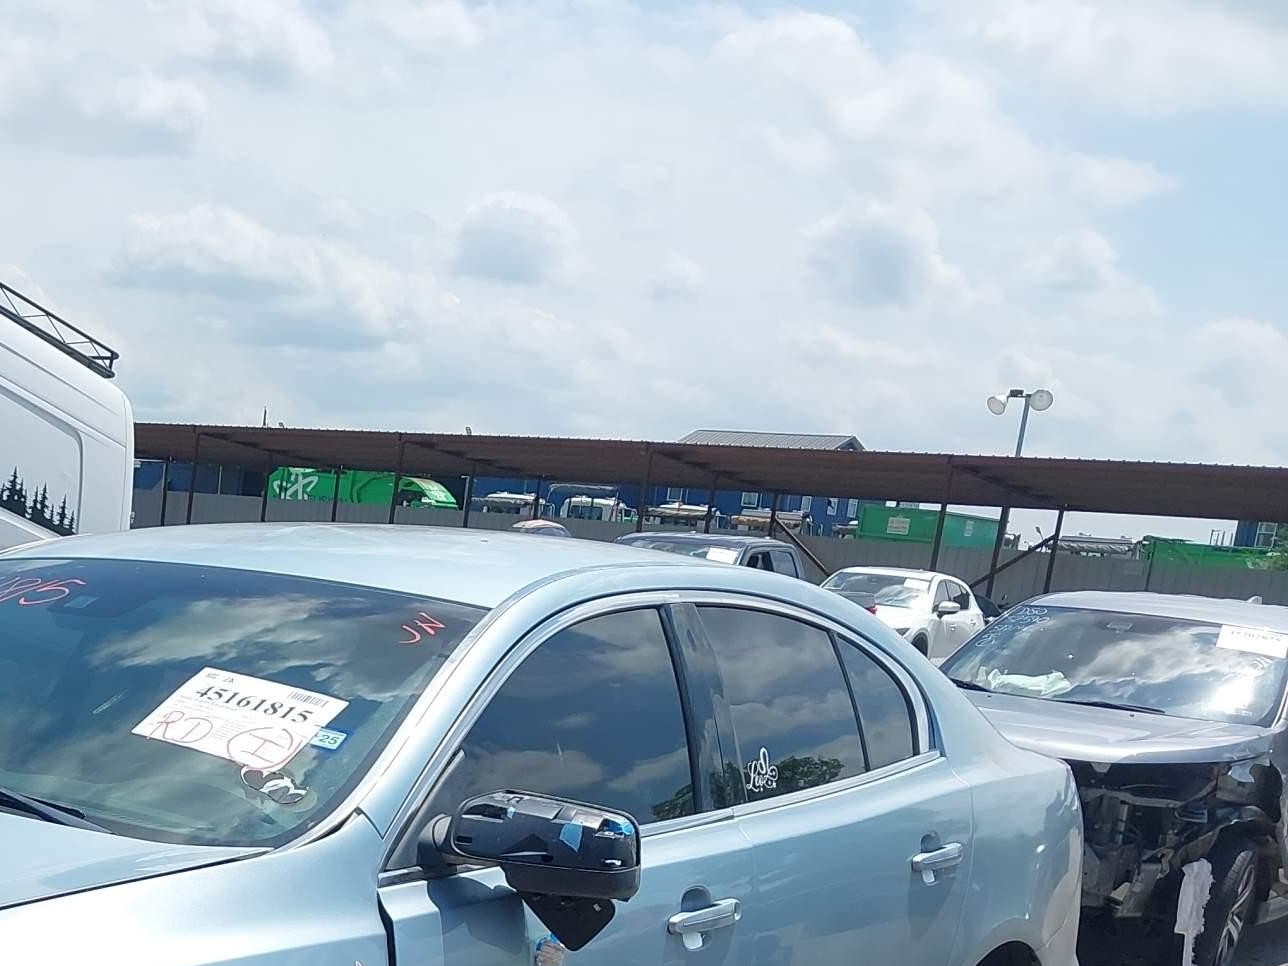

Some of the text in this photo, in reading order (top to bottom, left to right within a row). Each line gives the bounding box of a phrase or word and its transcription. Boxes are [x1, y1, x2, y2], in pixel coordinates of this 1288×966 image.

[196, 686, 315, 723] 45161815
[146, 710, 213, 744] RD
[317, 734, 340, 745] 25
